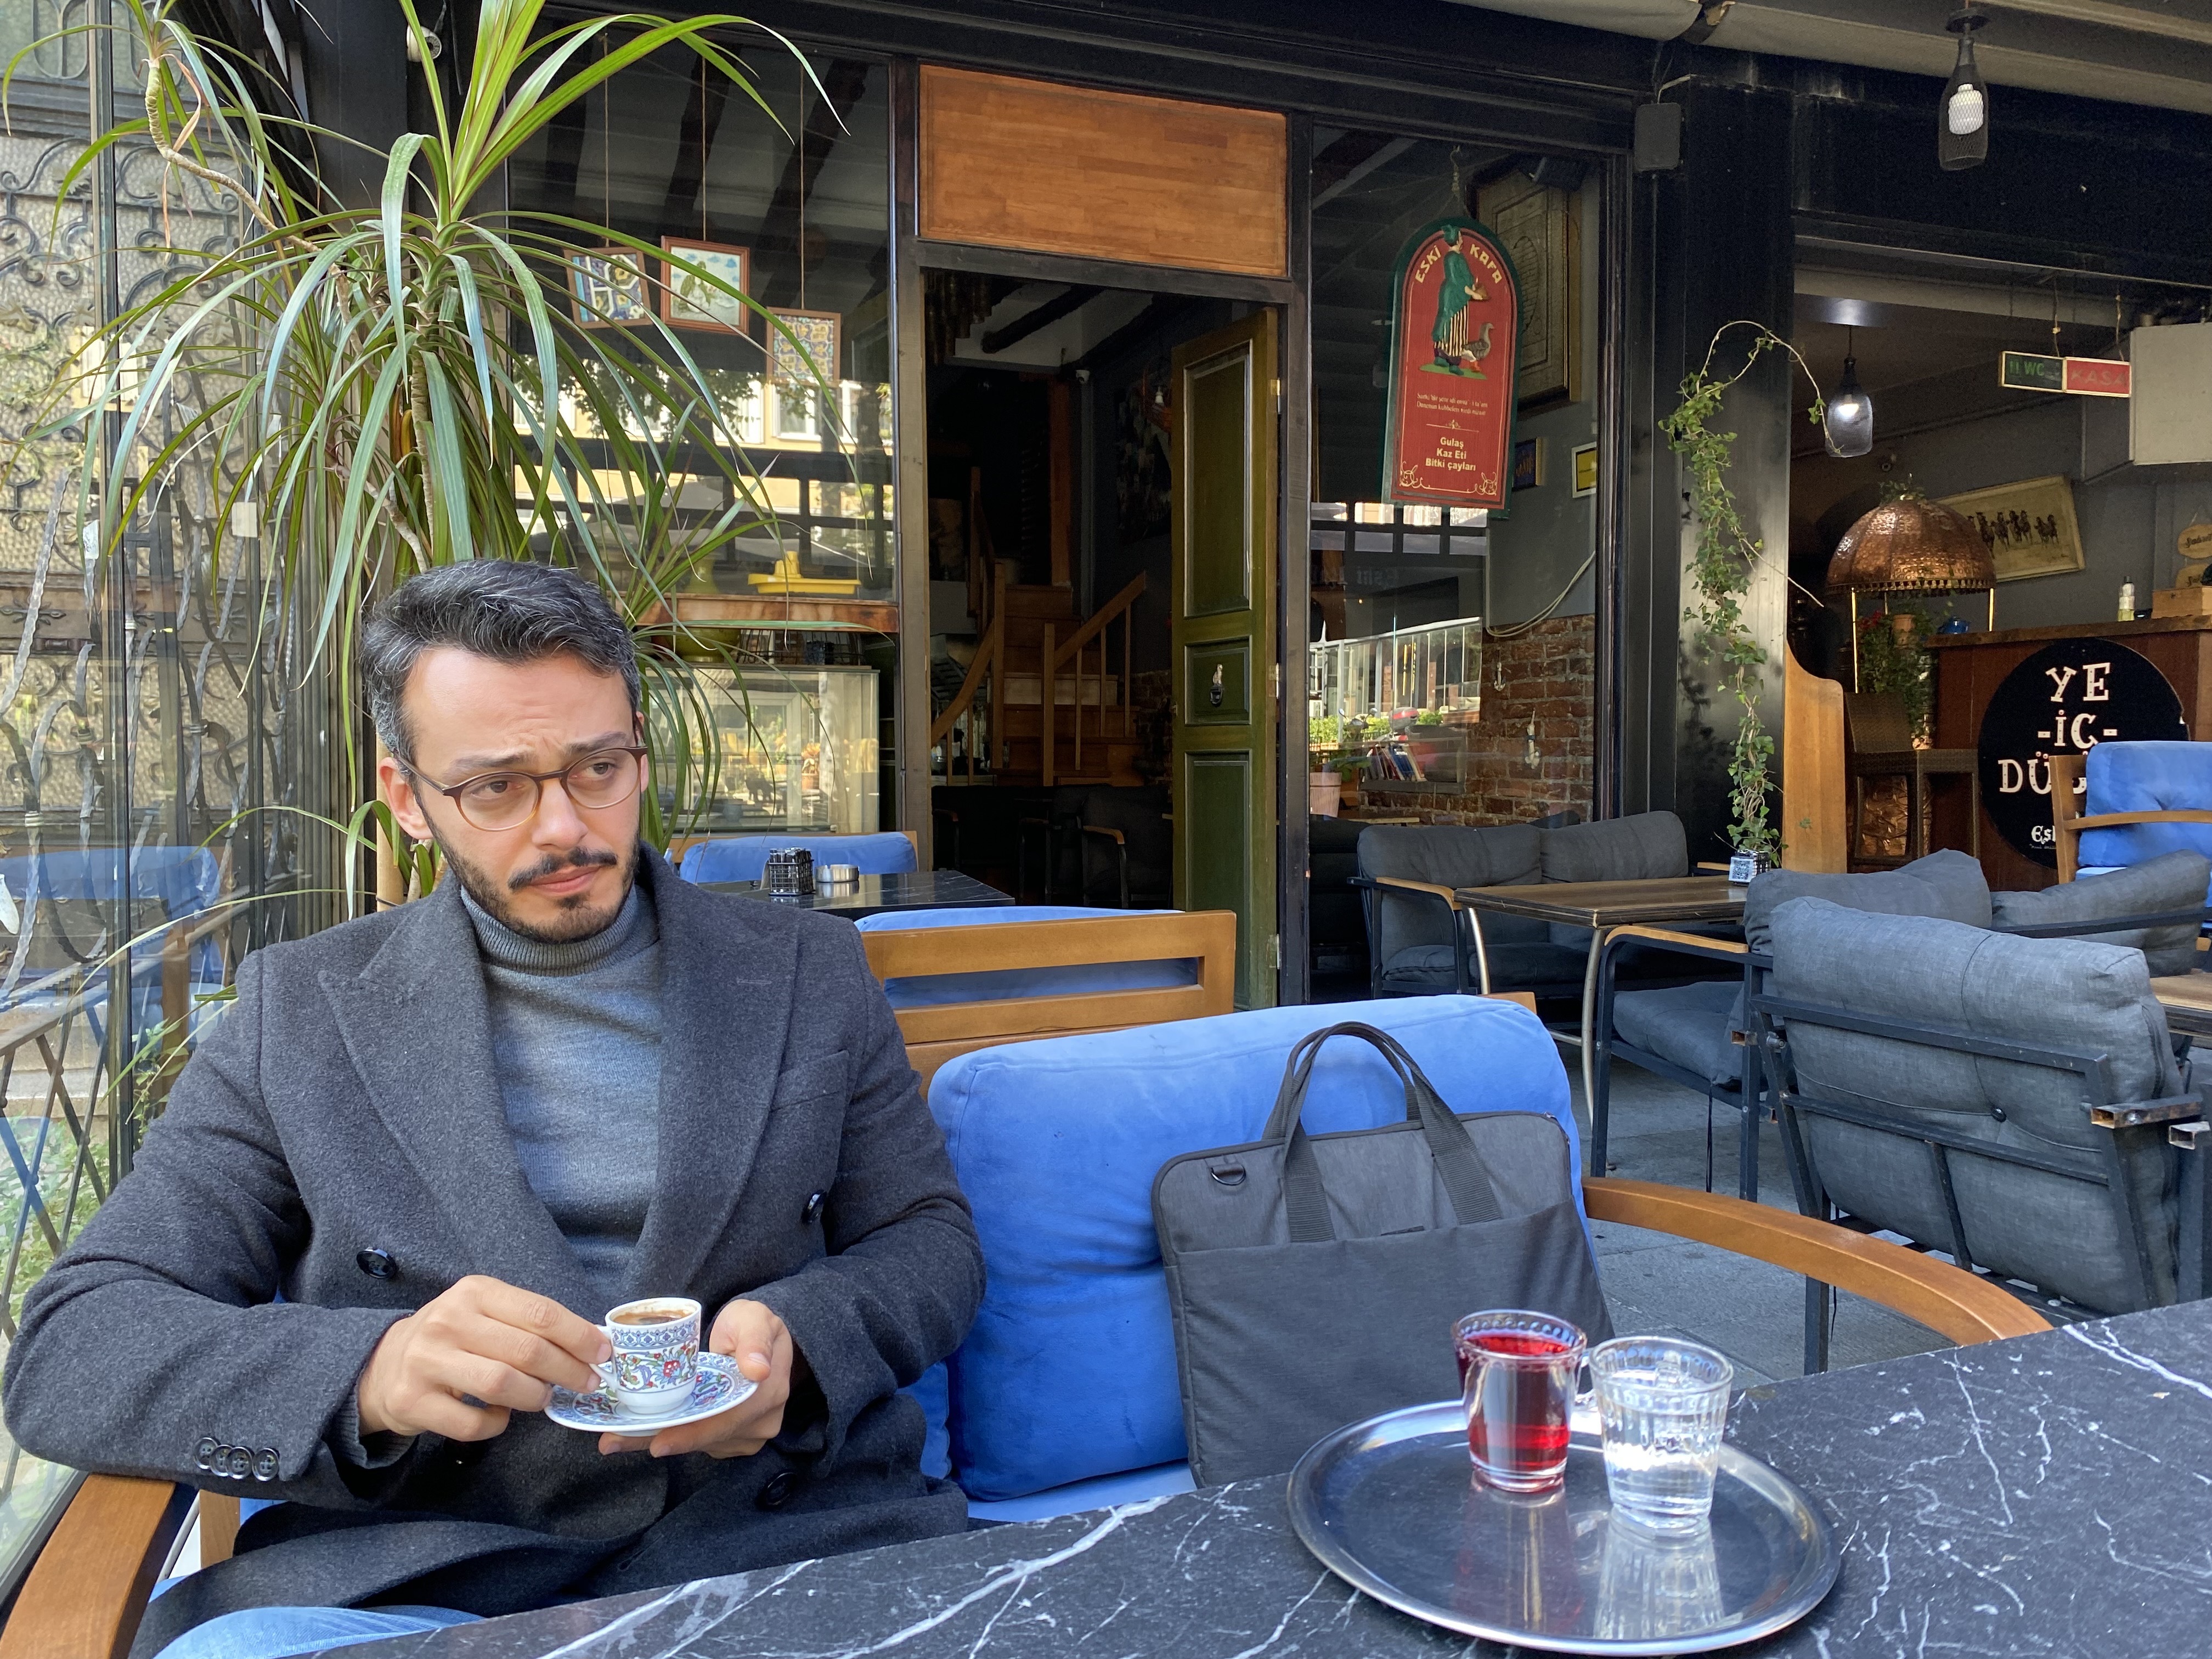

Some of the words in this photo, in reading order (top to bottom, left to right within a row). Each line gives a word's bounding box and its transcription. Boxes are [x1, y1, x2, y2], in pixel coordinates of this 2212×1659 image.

[1470, 244, 1502, 284] KAFA
[2024, 361, 2044, 376] WC
[2070, 369, 2129, 387] KASA
[1440, 437, 1464, 449] Gulaş
[1436, 448, 1452, 457] Kaz
[1455, 450, 1466, 459] Eti
[1425, 458, 1445, 467] Bitki
[1447, 461, 1476, 472] çayları
[2045, 662, 2111, 702] YE
